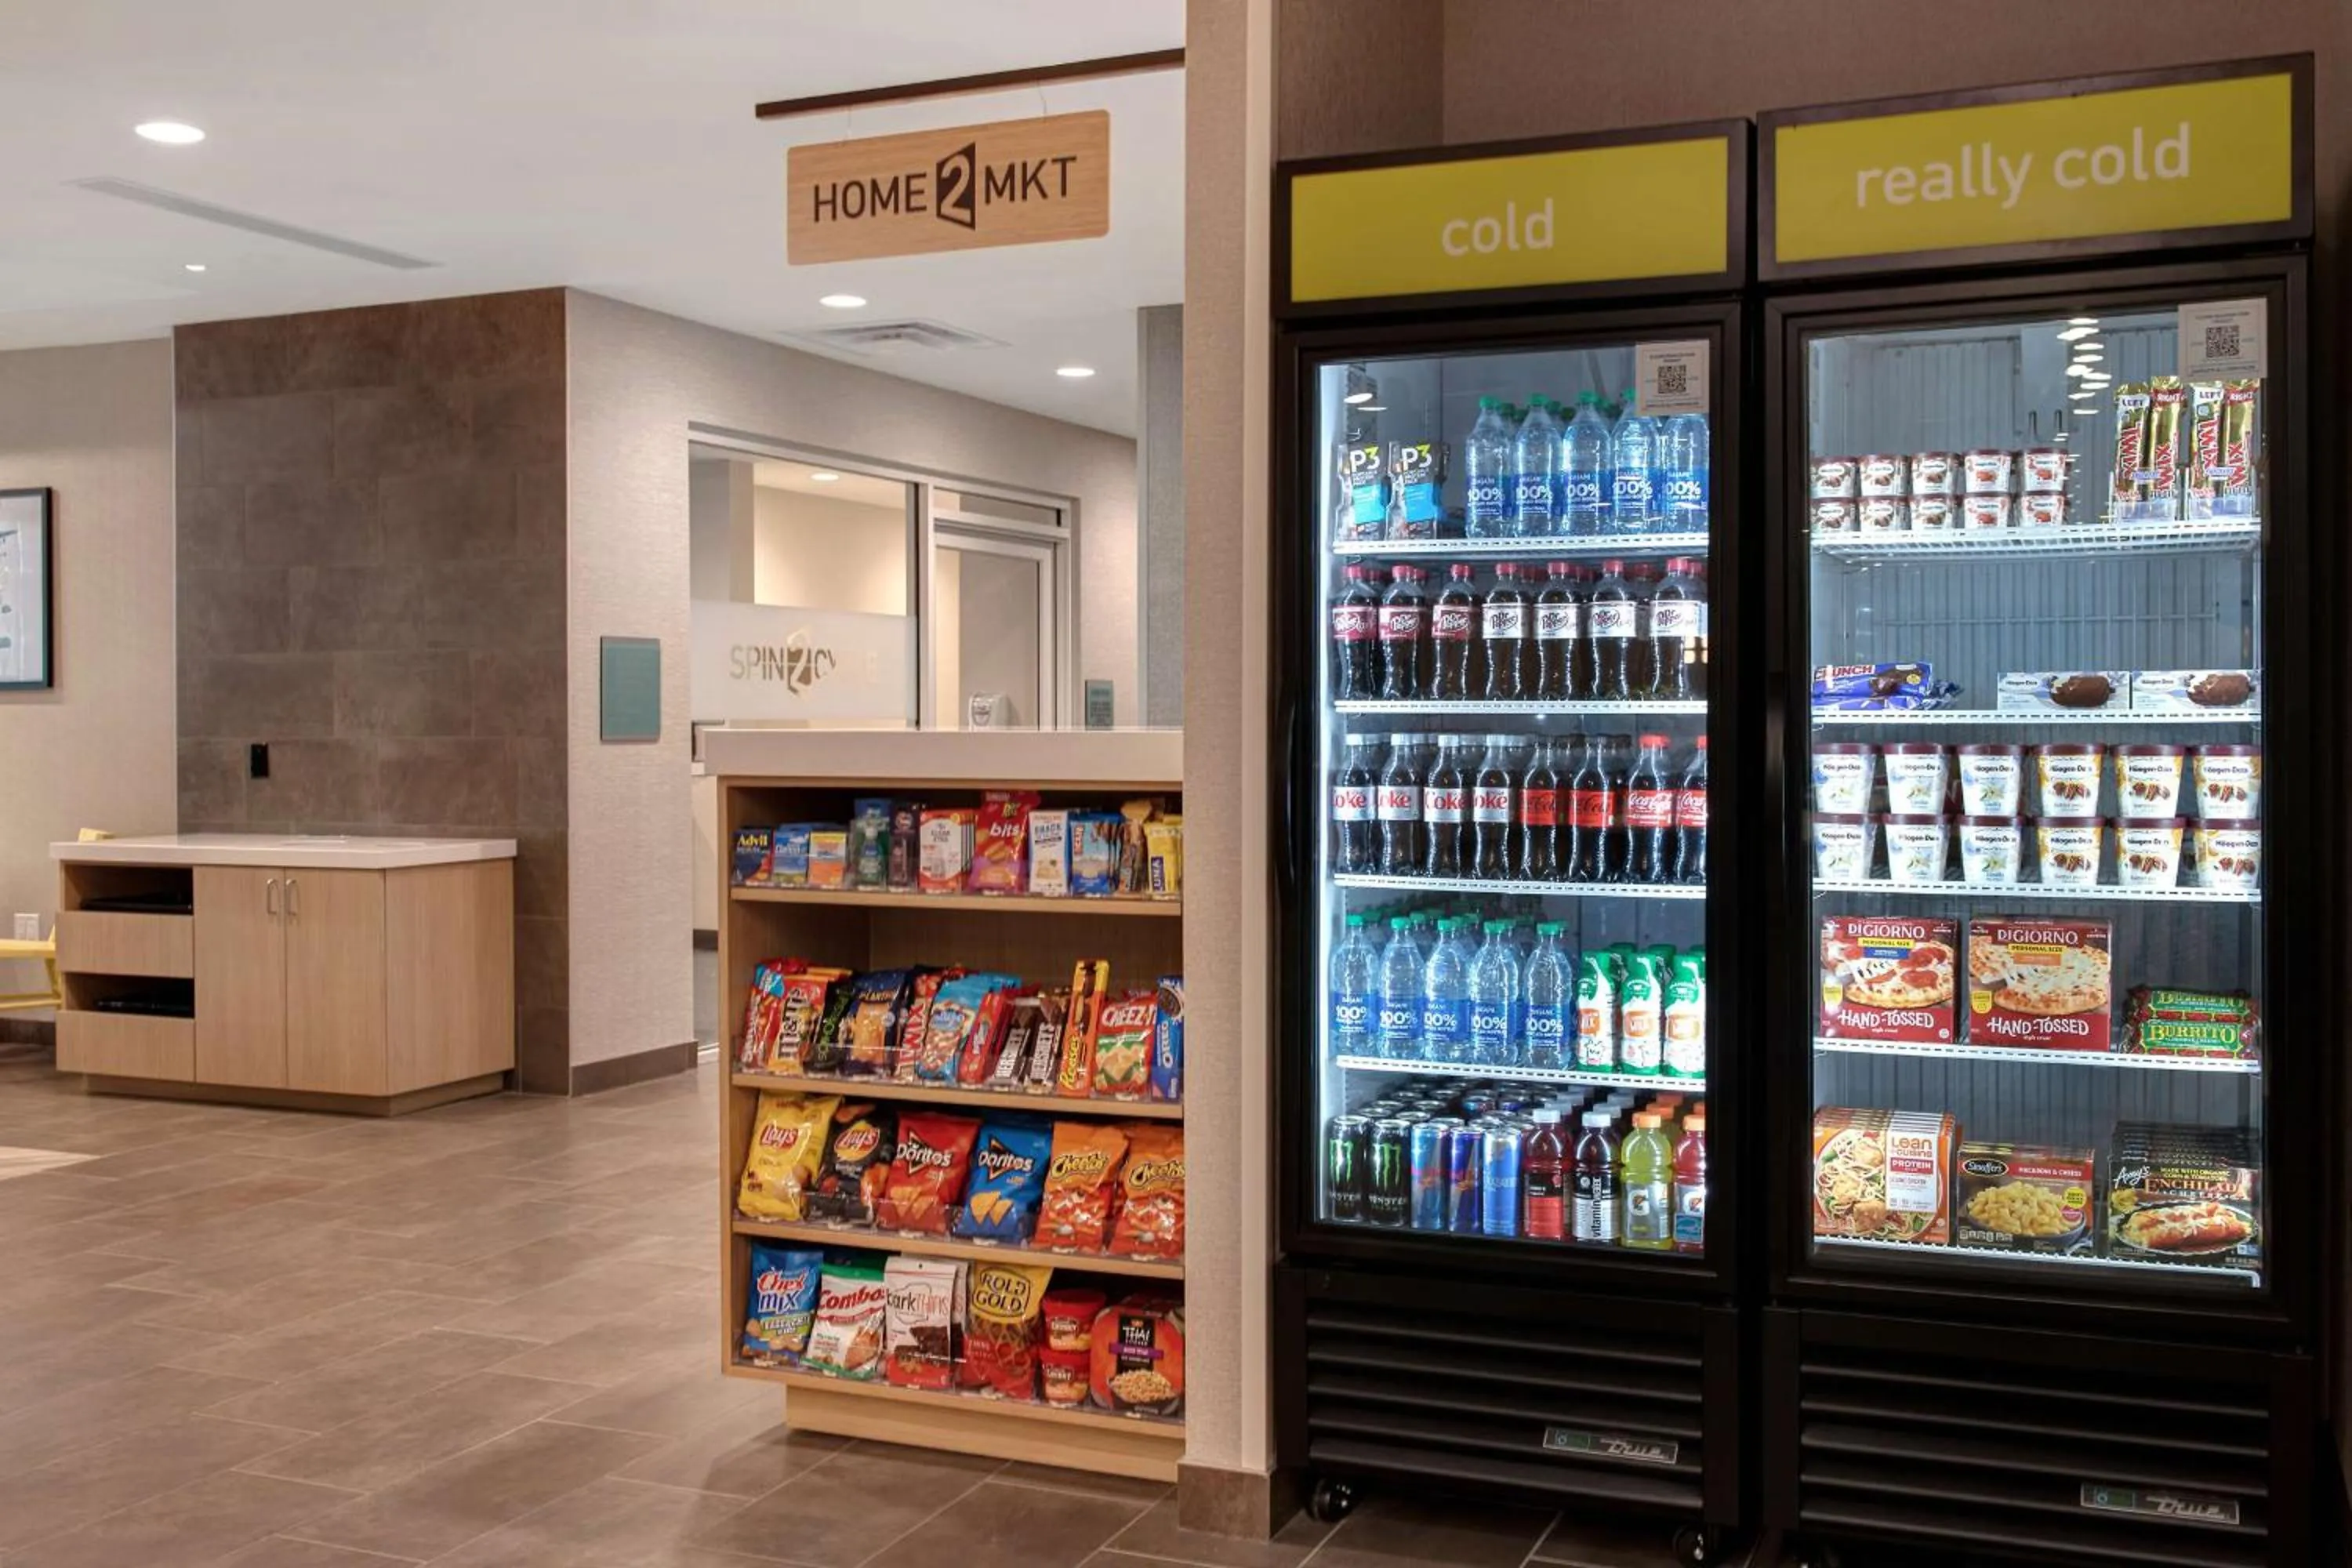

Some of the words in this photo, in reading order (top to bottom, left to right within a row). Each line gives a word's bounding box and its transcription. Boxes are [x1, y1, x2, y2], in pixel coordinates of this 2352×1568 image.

[1856, 141, 2032, 208] really
[2053, 124, 2190, 189] cold
[1441, 198, 1555, 256] cold
[1350, 446, 1380, 472] P3
[1402, 444, 1432, 470] P3
[1333, 790, 1367, 808] oke
[1475, 791, 1508, 809] oke
[737, 833, 768, 847] Advil
[1848, 922, 1926, 939] DIGIORNO
[1997, 929, 2079, 945] DIGIORNO
[2151, 1025, 2236, 1044] BURRITO
[896, 1141, 953, 1167] Doritos
[978, 1149, 1035, 1173] Doritos
[981, 1272, 1027, 1295] ROLD
[976, 1291, 1022, 1312] GOLD
[1122, 1326, 1151, 1341] THAI
